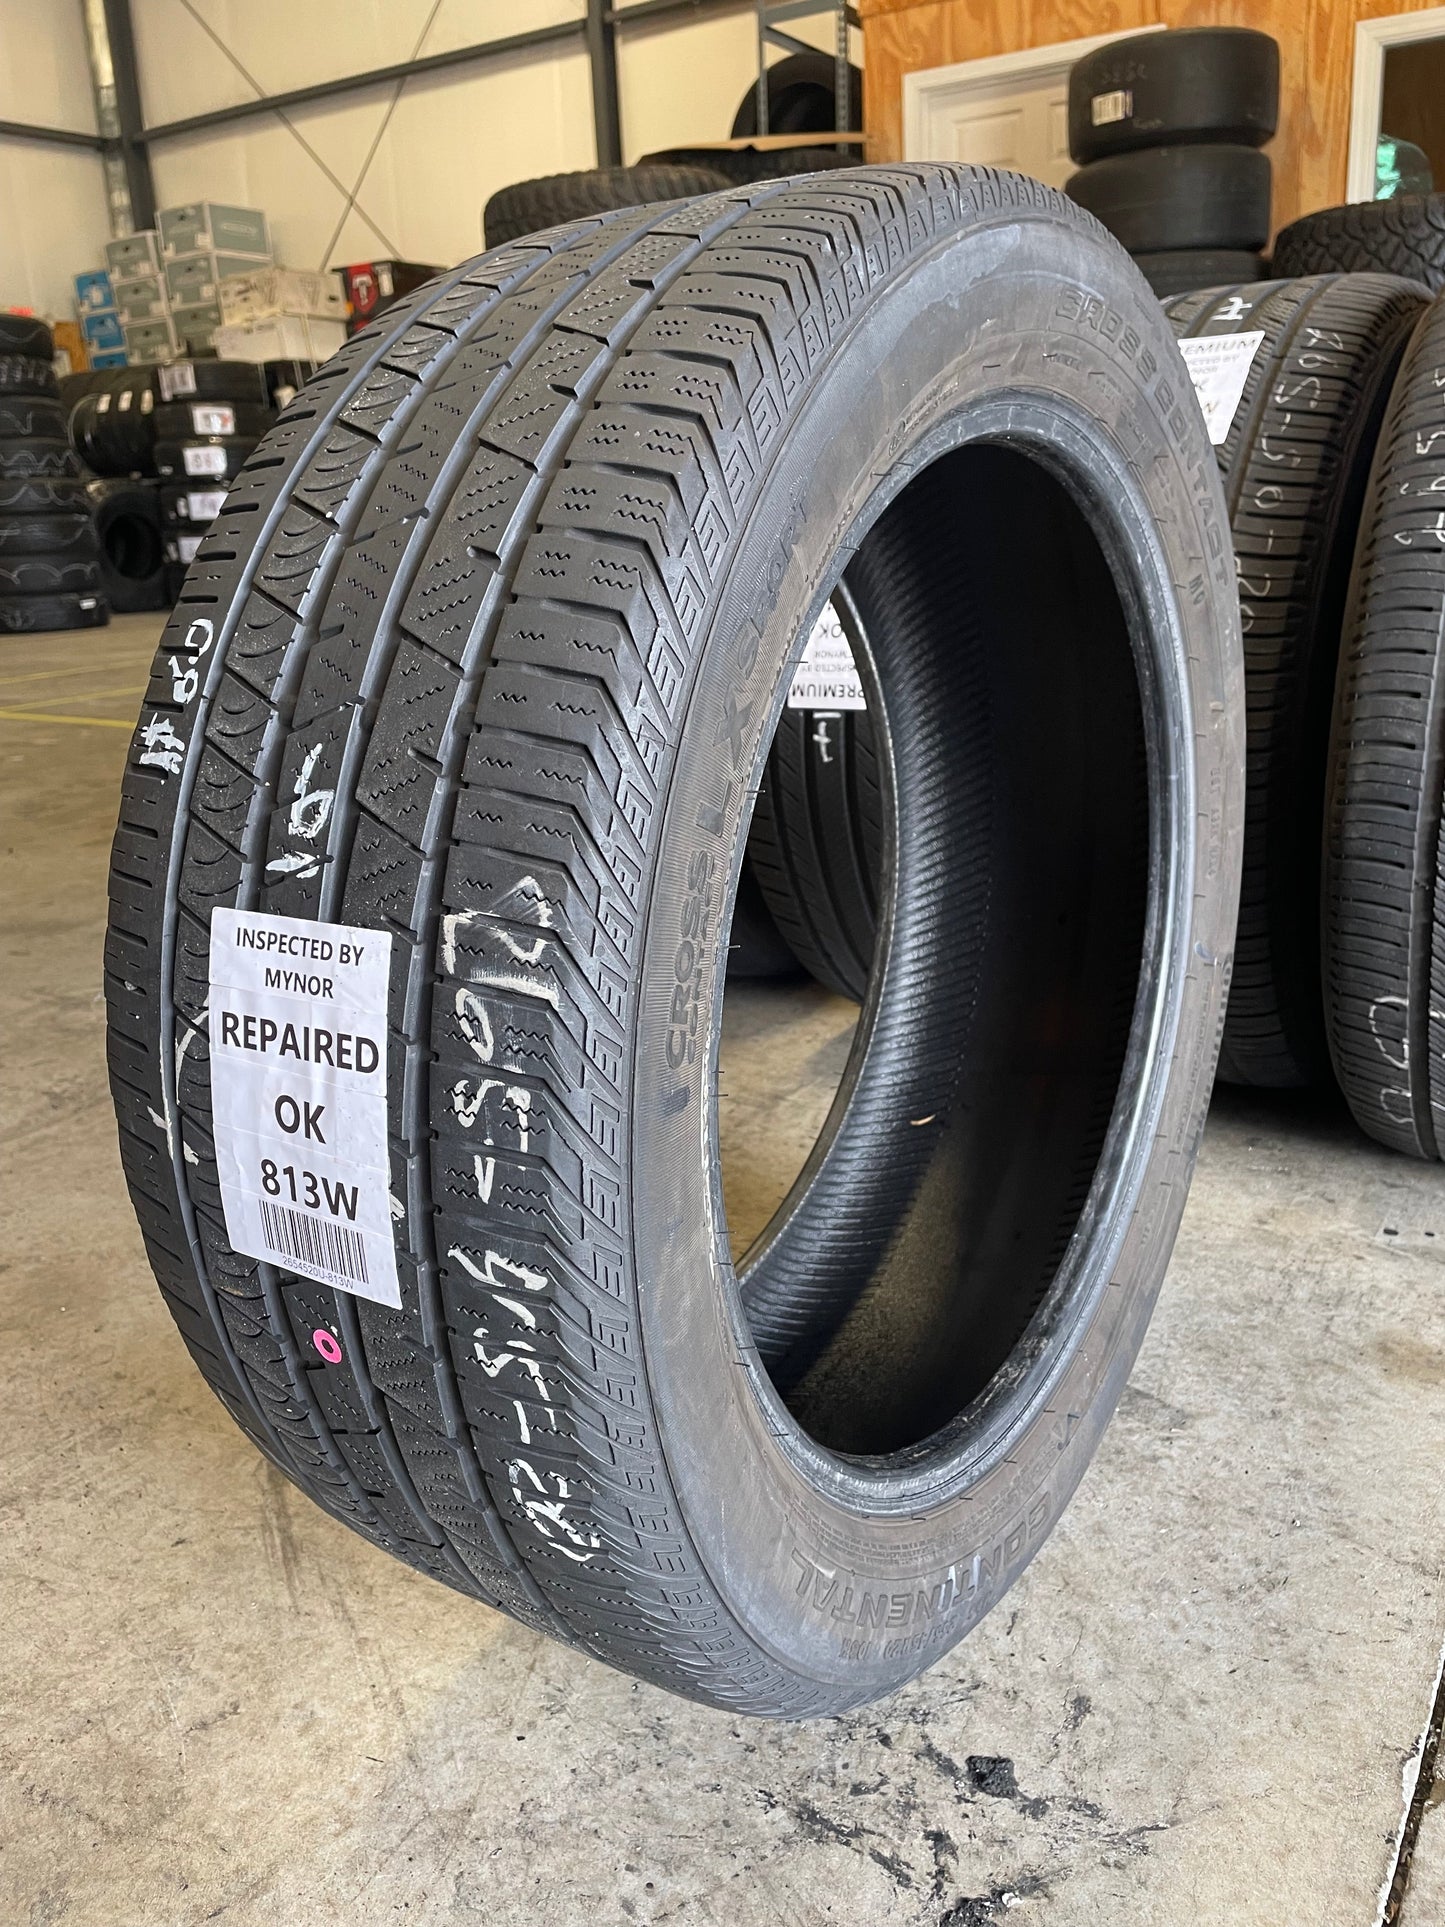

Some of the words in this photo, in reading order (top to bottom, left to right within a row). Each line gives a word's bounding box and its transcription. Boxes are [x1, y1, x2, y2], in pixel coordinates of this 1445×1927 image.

[1184, 339, 1257, 355] EMIUM
[791, 683, 865, 698] PREMIUM
[236, 926, 334, 961] INSPECTED
[338, 942, 365, 967] BY
[664, 849, 708, 1070] CROSS
[264, 967, 334, 999] MYNOR
[221, 1011, 380, 1075] REPAIRED
[274, 1094, 327, 1145] OK
[260, 1158, 360, 1222] 813W
[791, 1491, 1051, 1630] CONTINENTAL
